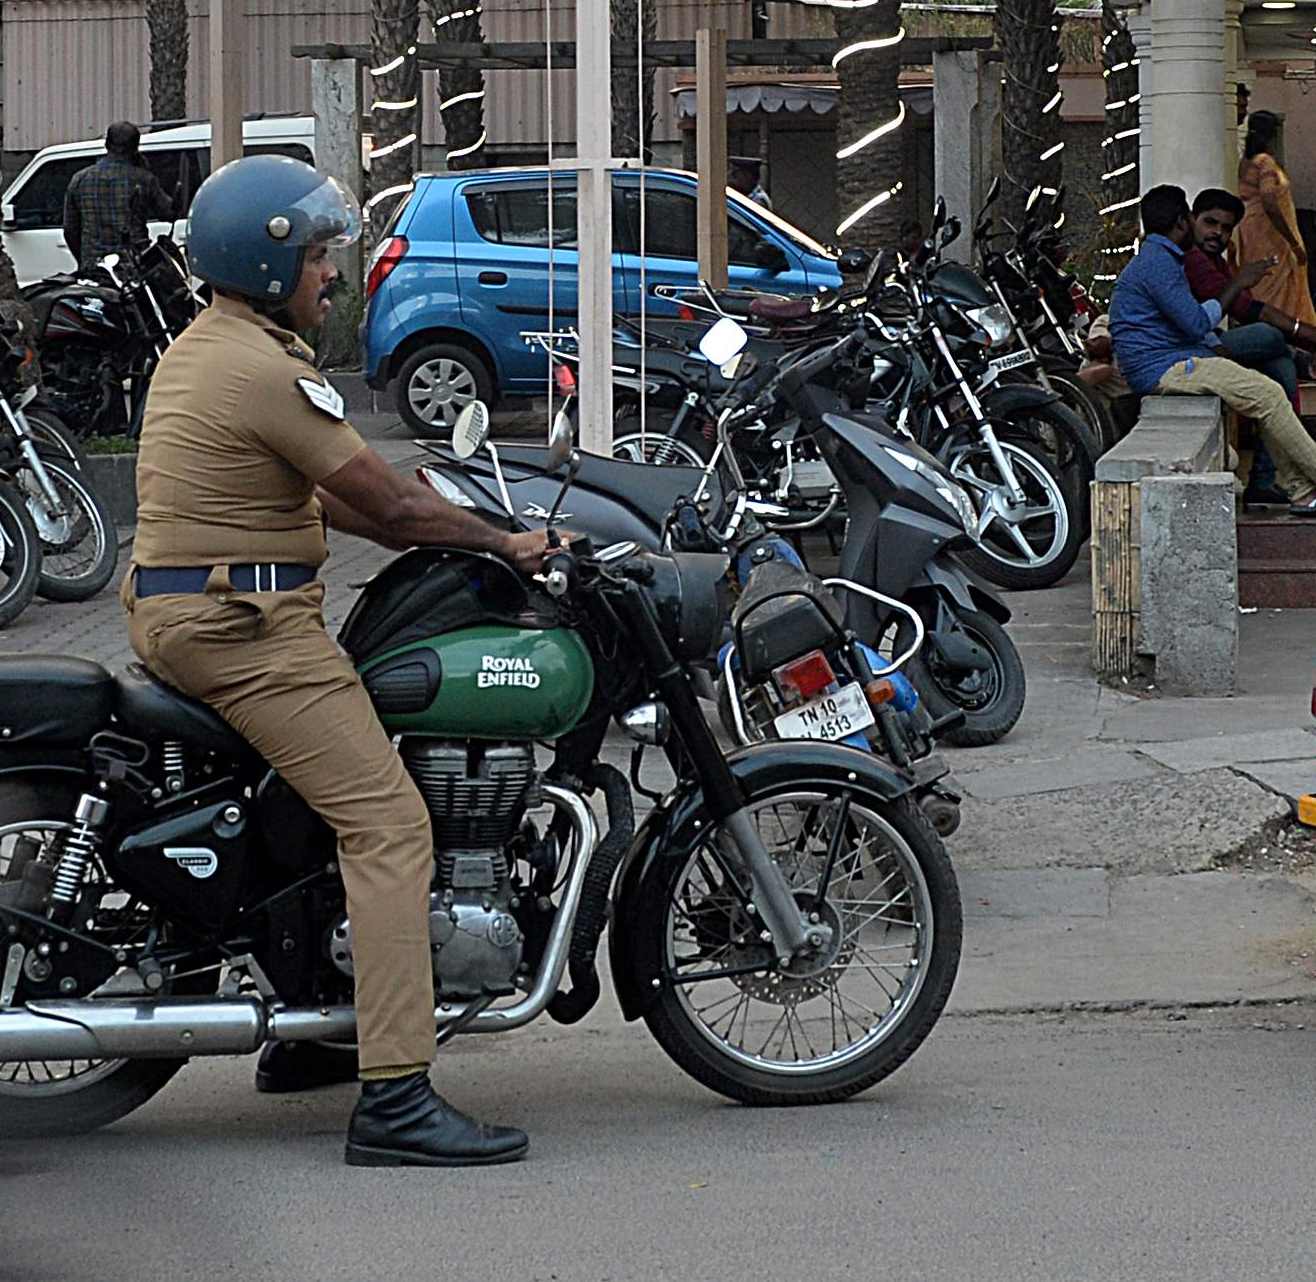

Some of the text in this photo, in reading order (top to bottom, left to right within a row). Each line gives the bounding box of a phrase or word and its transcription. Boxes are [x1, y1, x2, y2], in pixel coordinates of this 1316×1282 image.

[482, 655, 534, 672] ROYAL
[477, 671, 541, 689] ENFIELD
[798, 698, 837, 727] TN 10
[820, 715, 852, 739] 4513
